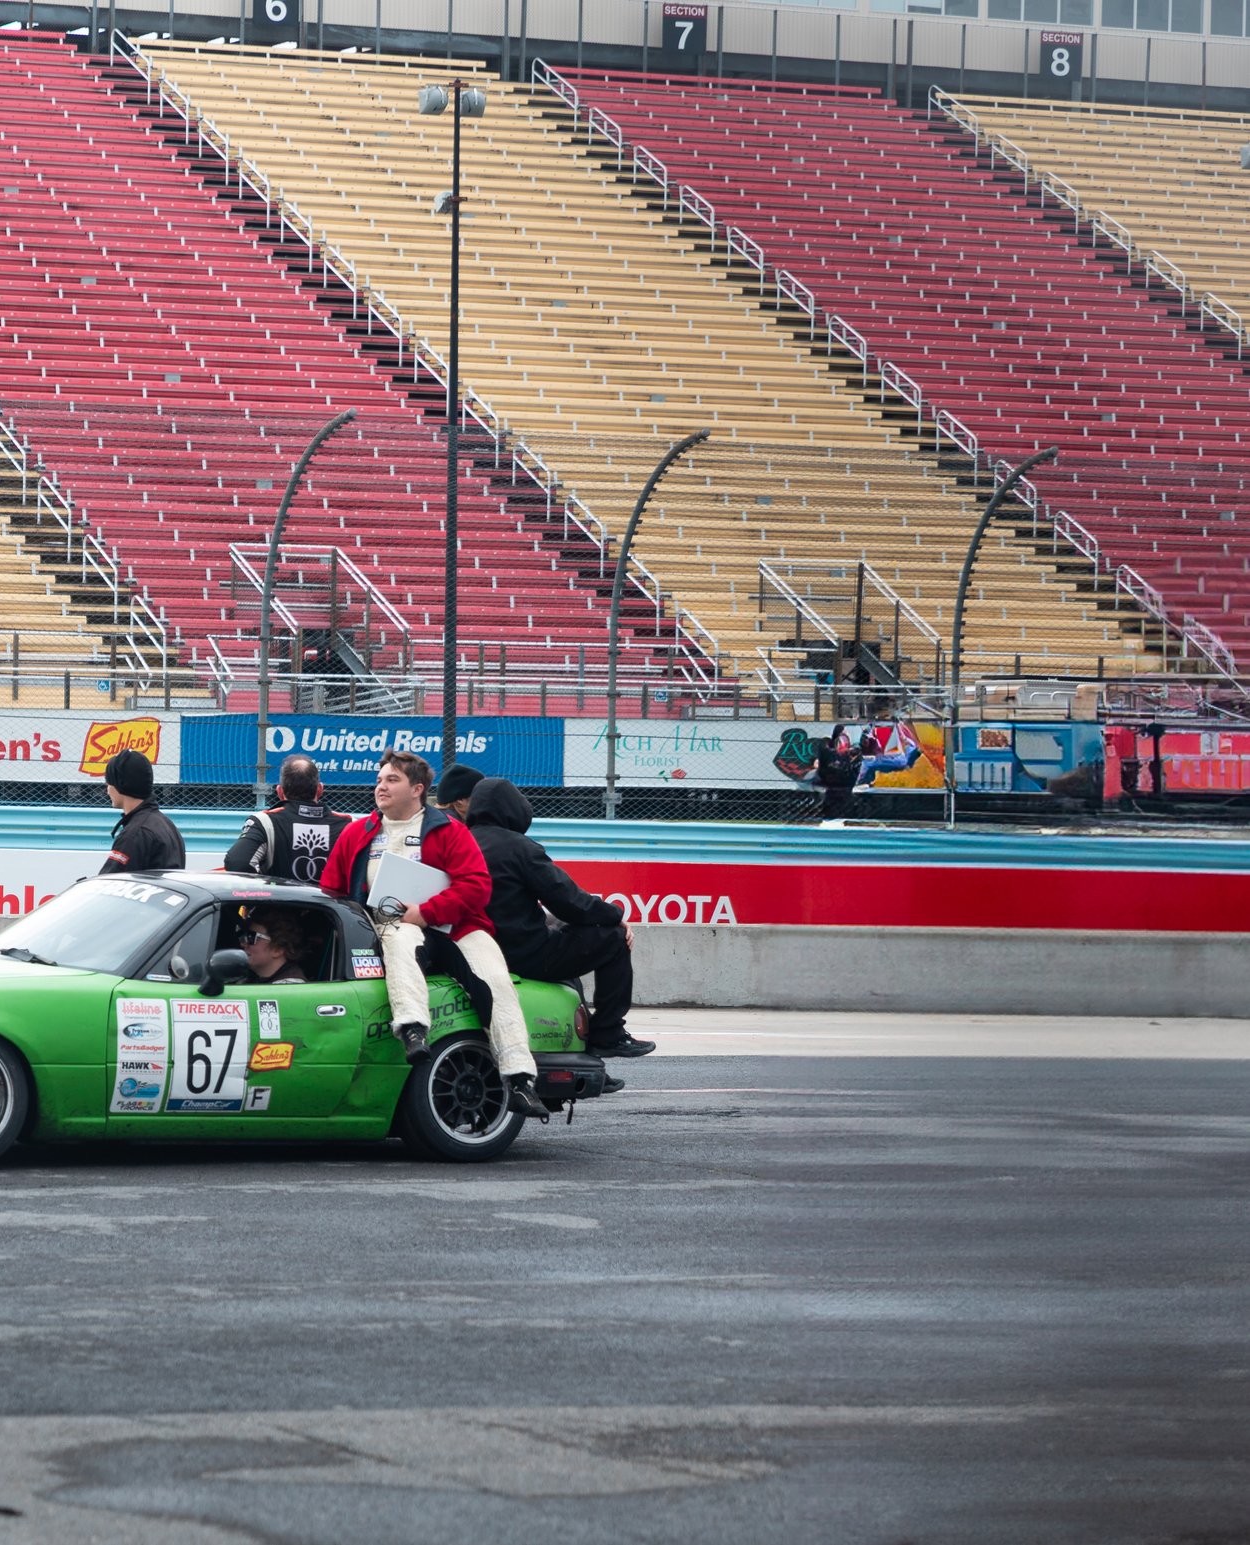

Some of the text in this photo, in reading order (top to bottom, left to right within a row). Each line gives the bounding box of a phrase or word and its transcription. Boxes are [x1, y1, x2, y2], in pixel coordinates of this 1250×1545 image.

[265, 0, 287, 22] 6
[664, 5, 705, 17] SECTION
[675, 21, 694, 50] 7
[1042, 33, 1080, 44] SECTION
[1051, 48, 1070, 77] 8
[300, 726, 488, 753] United Renals
[313, 759, 382, 772] ork Unite
[634, 755, 683, 767] FLORIST
[590, 893, 738, 924] OYOTA
[354, 958, 380, 968] LIQUI
[355, 967, 384, 977] MOLY
[177, 1003, 244, 1020] TIRE RACK
[120, 1044, 166, 1052] PartsBadger
[122, 1062, 150, 1070] HAWK
[186, 1028, 239, 1095] 67
[250, 1088, 266, 1108] F
